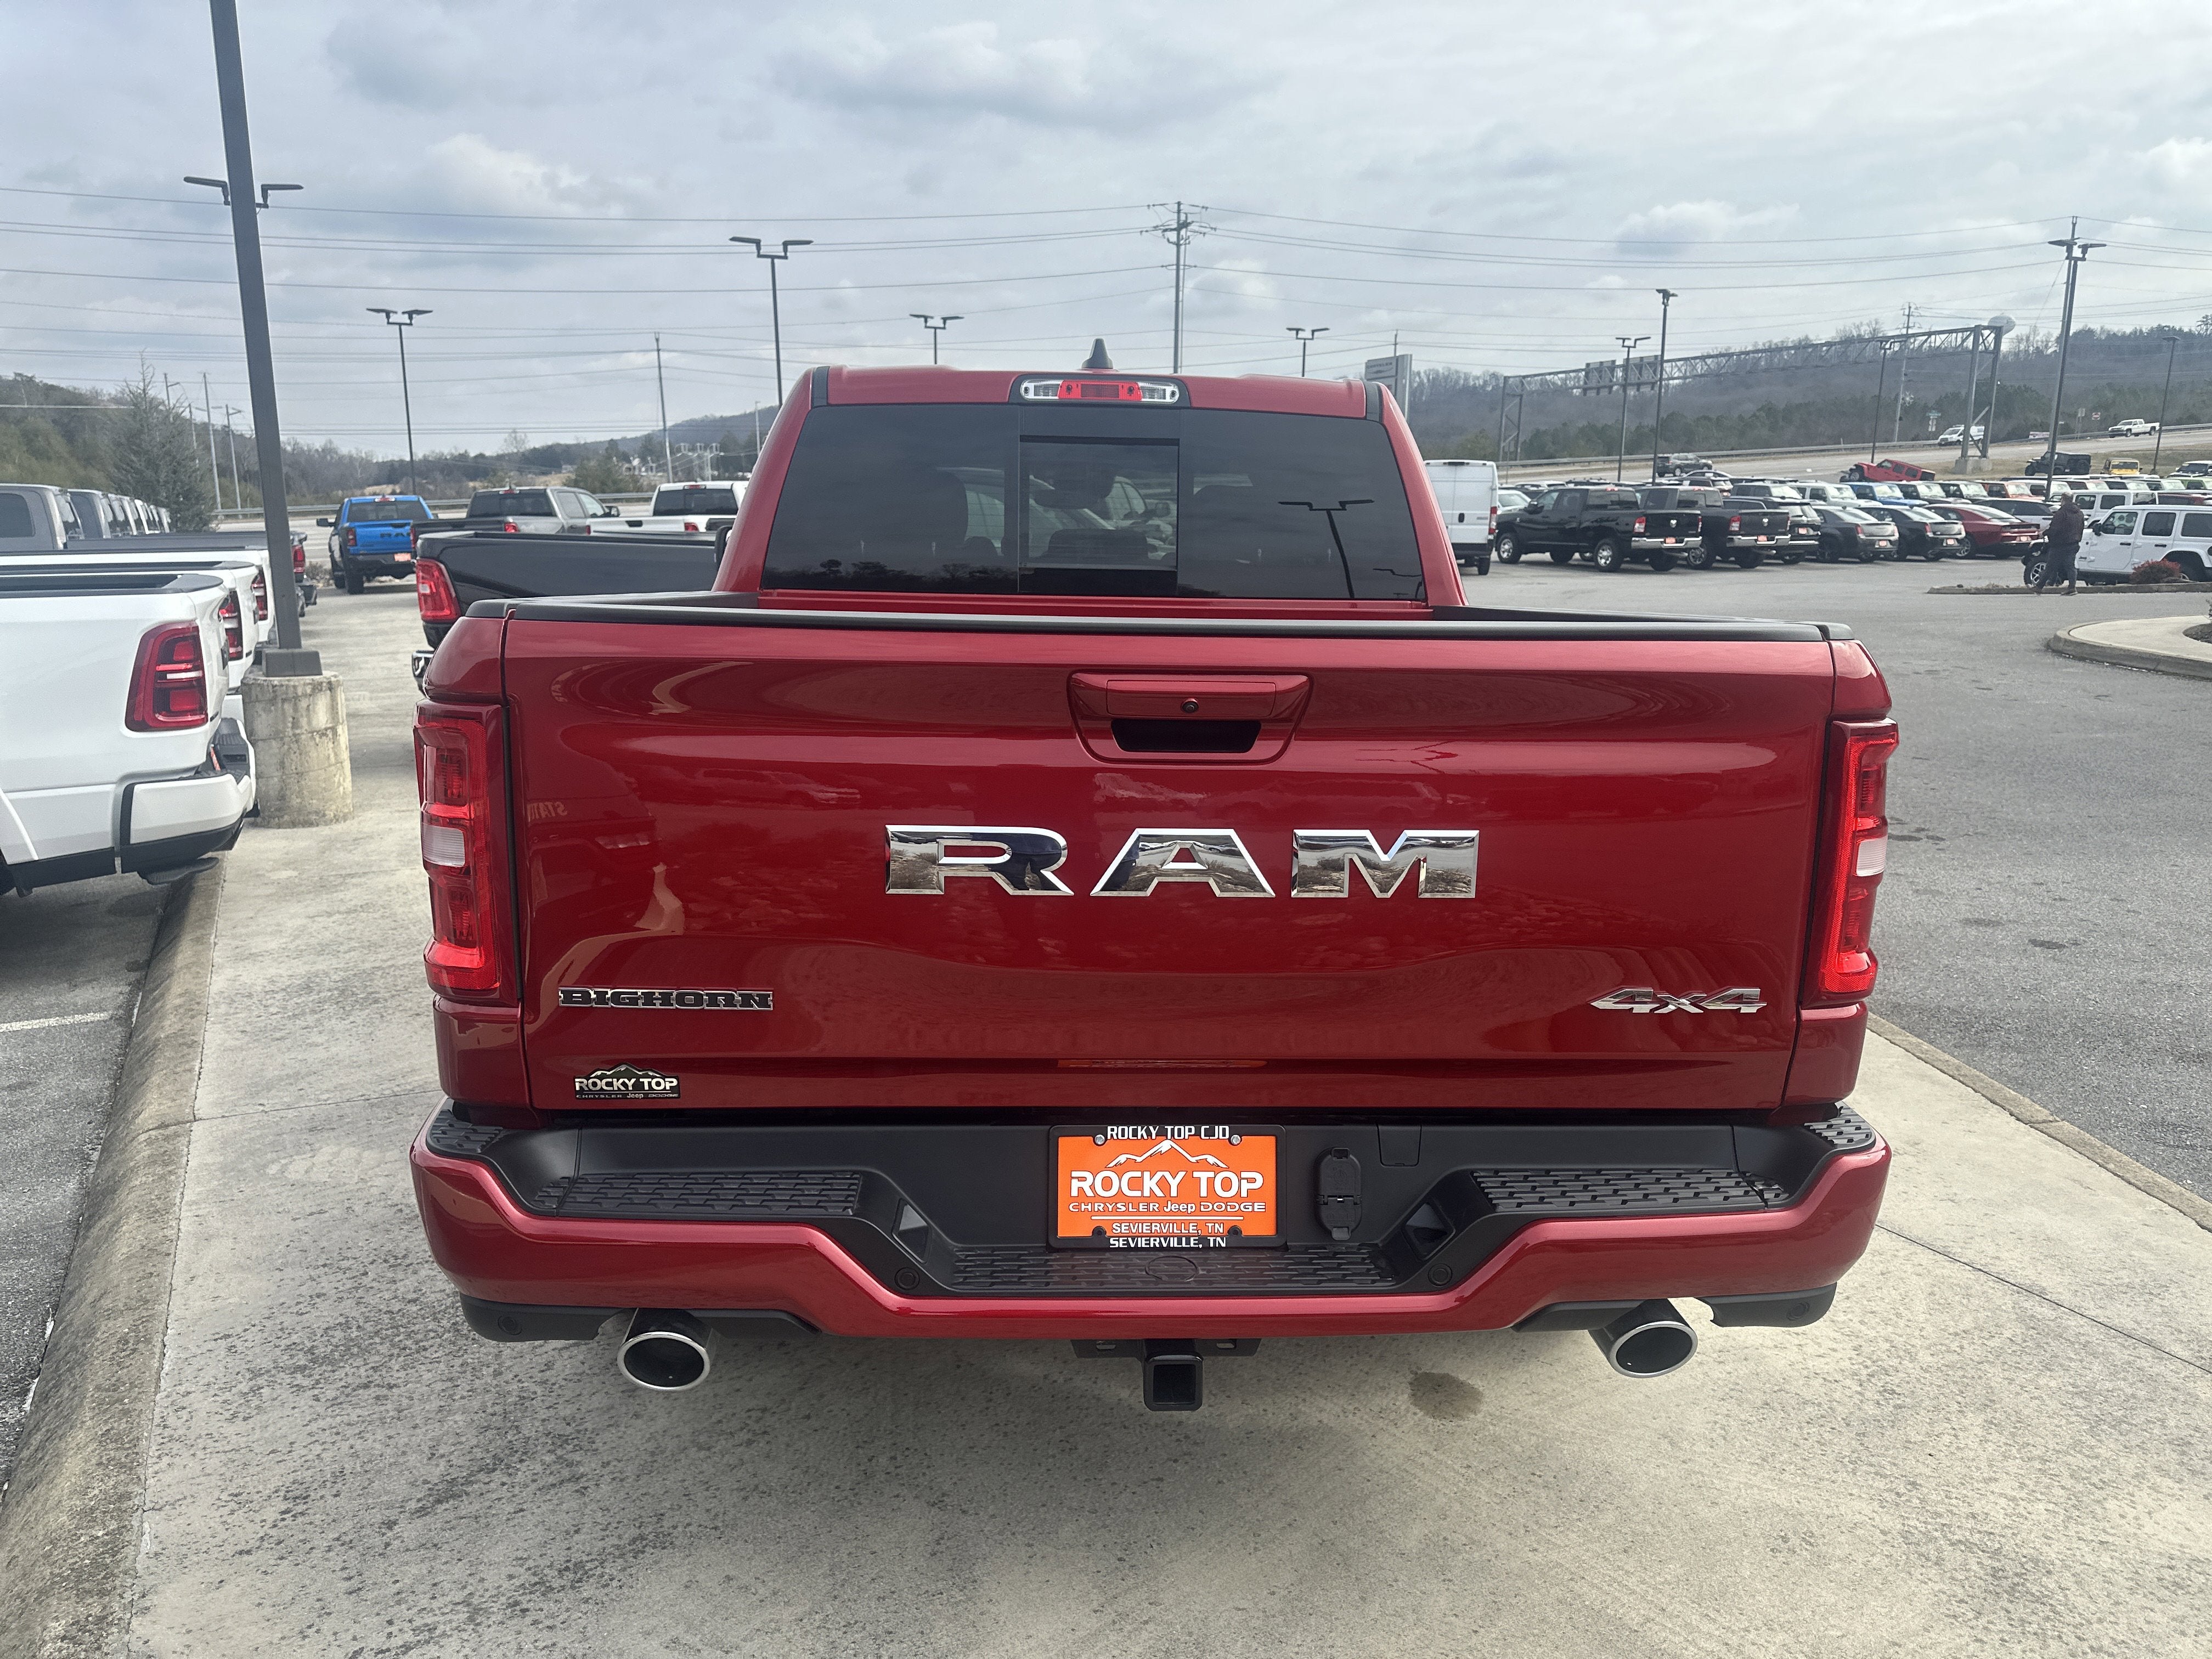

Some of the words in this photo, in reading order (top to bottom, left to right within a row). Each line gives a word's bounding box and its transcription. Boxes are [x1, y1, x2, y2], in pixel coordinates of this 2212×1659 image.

[884, 824, 1481, 899] RAM
[558, 987, 774, 1011] BIGHORN
[1590, 988, 1767, 1013] 4x4
[574, 1077, 636, 1091] ROCKY
[639, 1077, 679, 1091] TOP
[1107, 1125, 1159, 1140] ROCKY
[1164, 1125, 1195, 1140] TOP
[1200, 1125, 1229, 1140] CJD
[1070, 1170, 1188, 1198] ROCKY
[1192, 1170, 1265, 1198] TOP
[1068, 1201, 1160, 1212] CHRYSLER
[1163, 1200, 1196, 1215] Jeep
[1200, 1201, 1266, 1212] DODGE
[1111, 1222, 1202, 1235] SEVIERVILLE,
[1205, 1222, 1224, 1234] TN
[1109, 1236, 1203, 1249] SEVIERVILLE,
[1207, 1236, 1227, 1248] TN
